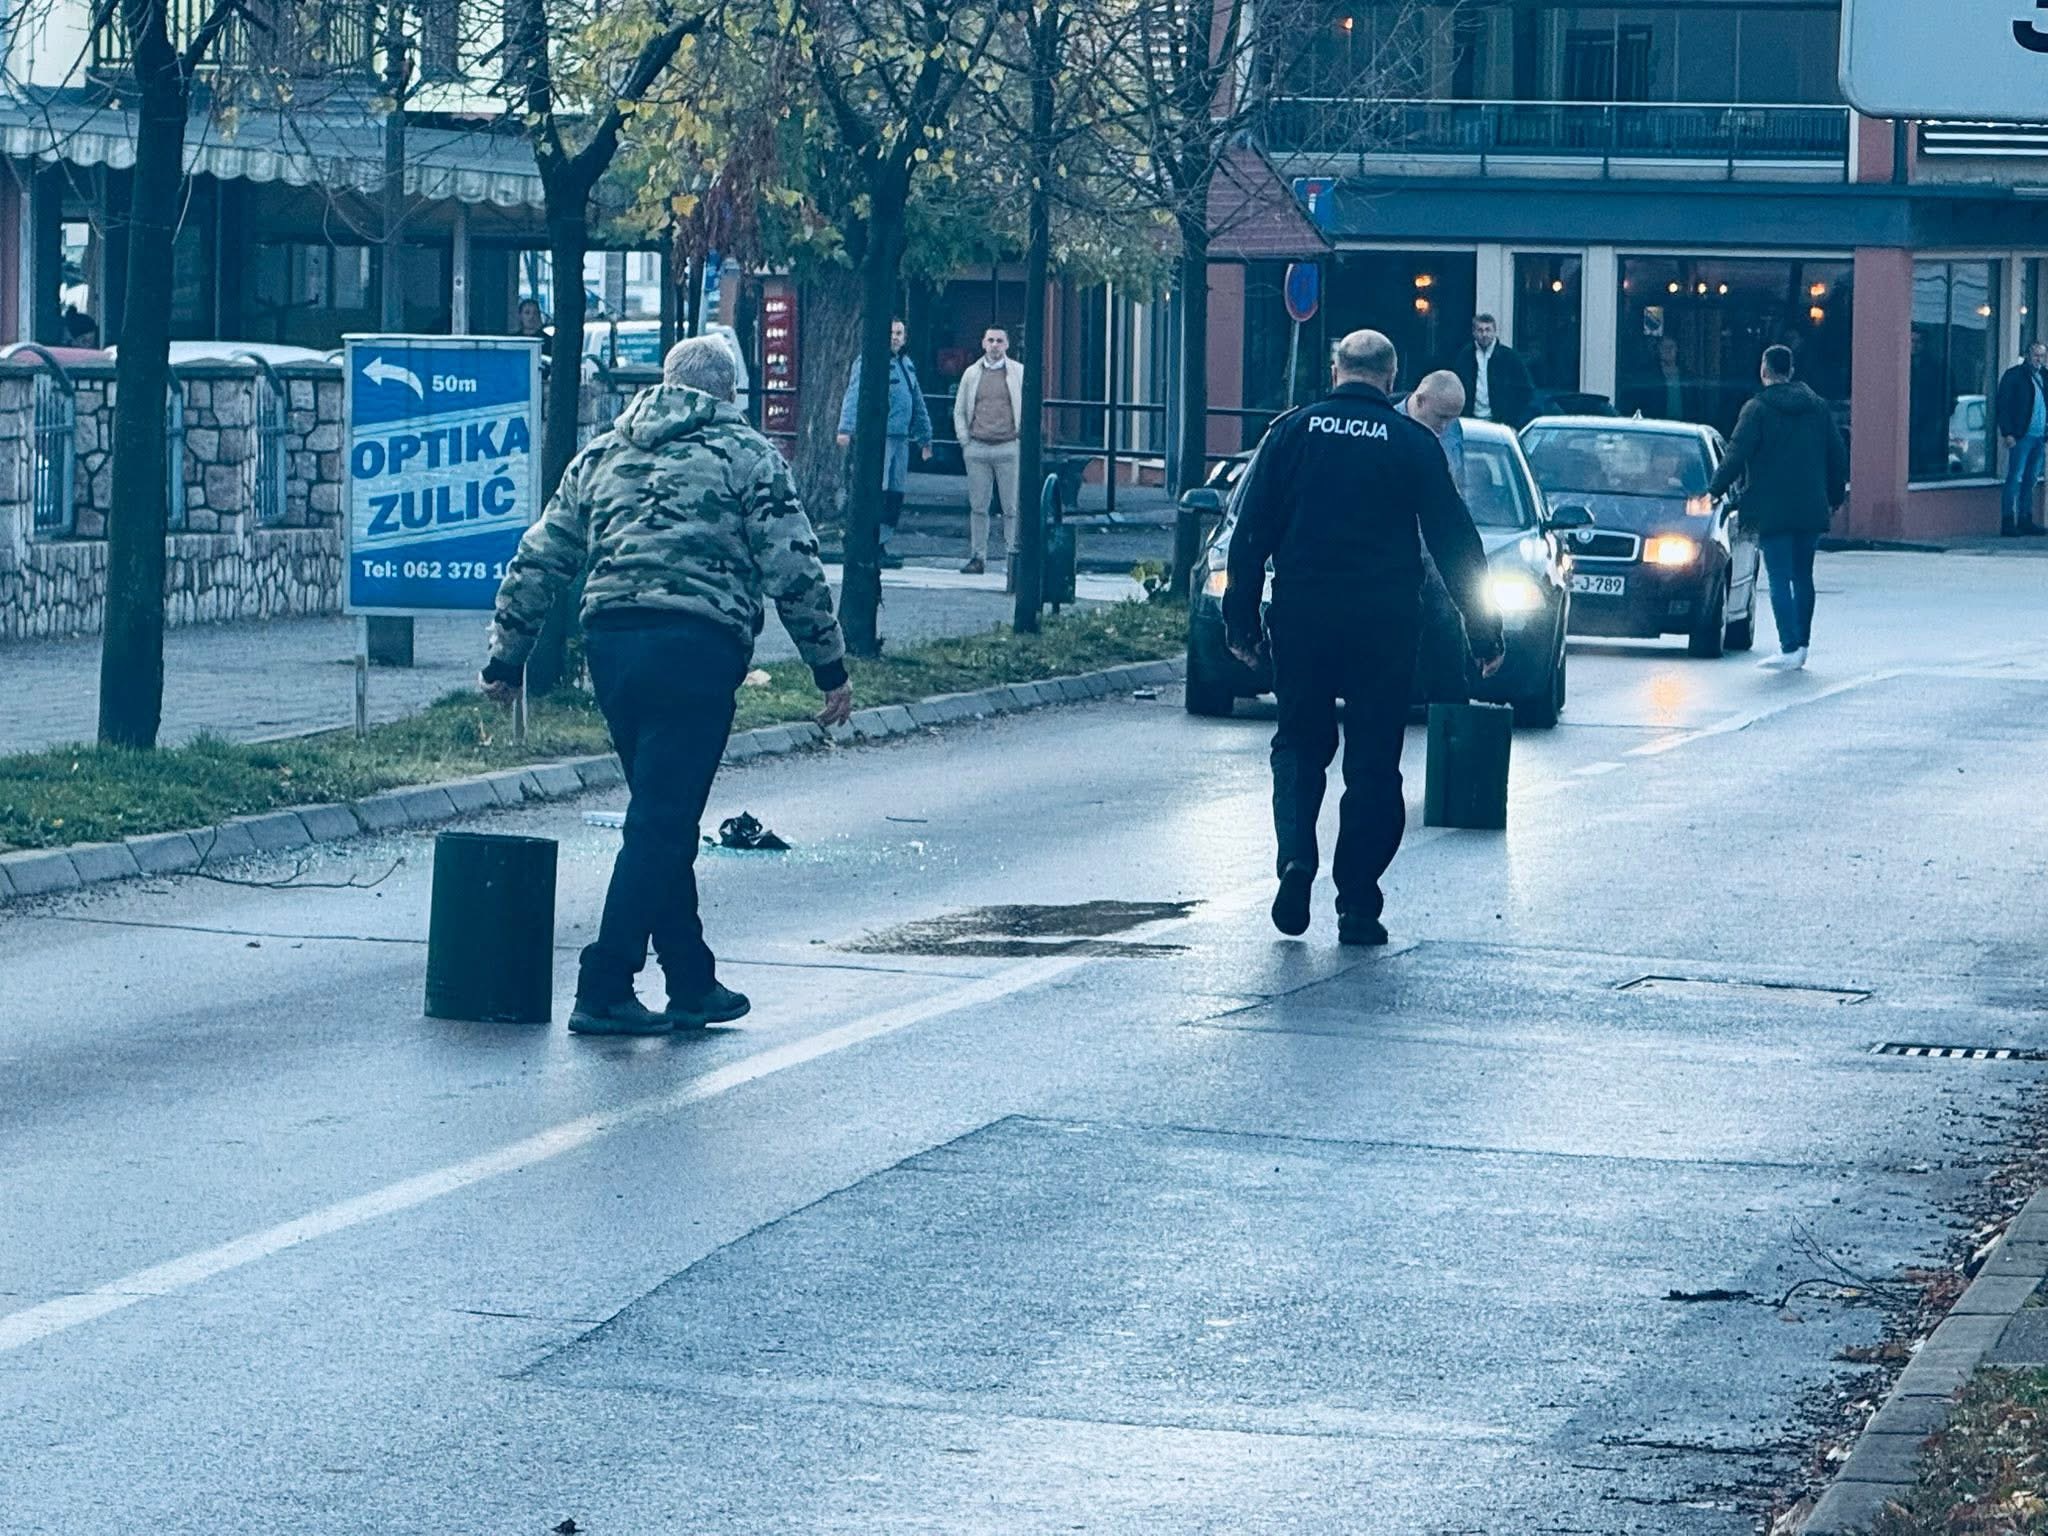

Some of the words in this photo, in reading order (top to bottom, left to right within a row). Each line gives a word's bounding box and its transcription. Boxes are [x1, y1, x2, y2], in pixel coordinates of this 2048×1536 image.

[431, 374, 477, 393] 50m
[1308, 416, 1388, 440] POLICIJA
[351, 416, 530, 480] OPTIKA
[367, 463, 516, 536] ZULIĆ
[362, 560, 398, 578] Tel:
[403, 560, 442, 579] 062
[448, 561, 487, 580] 378
